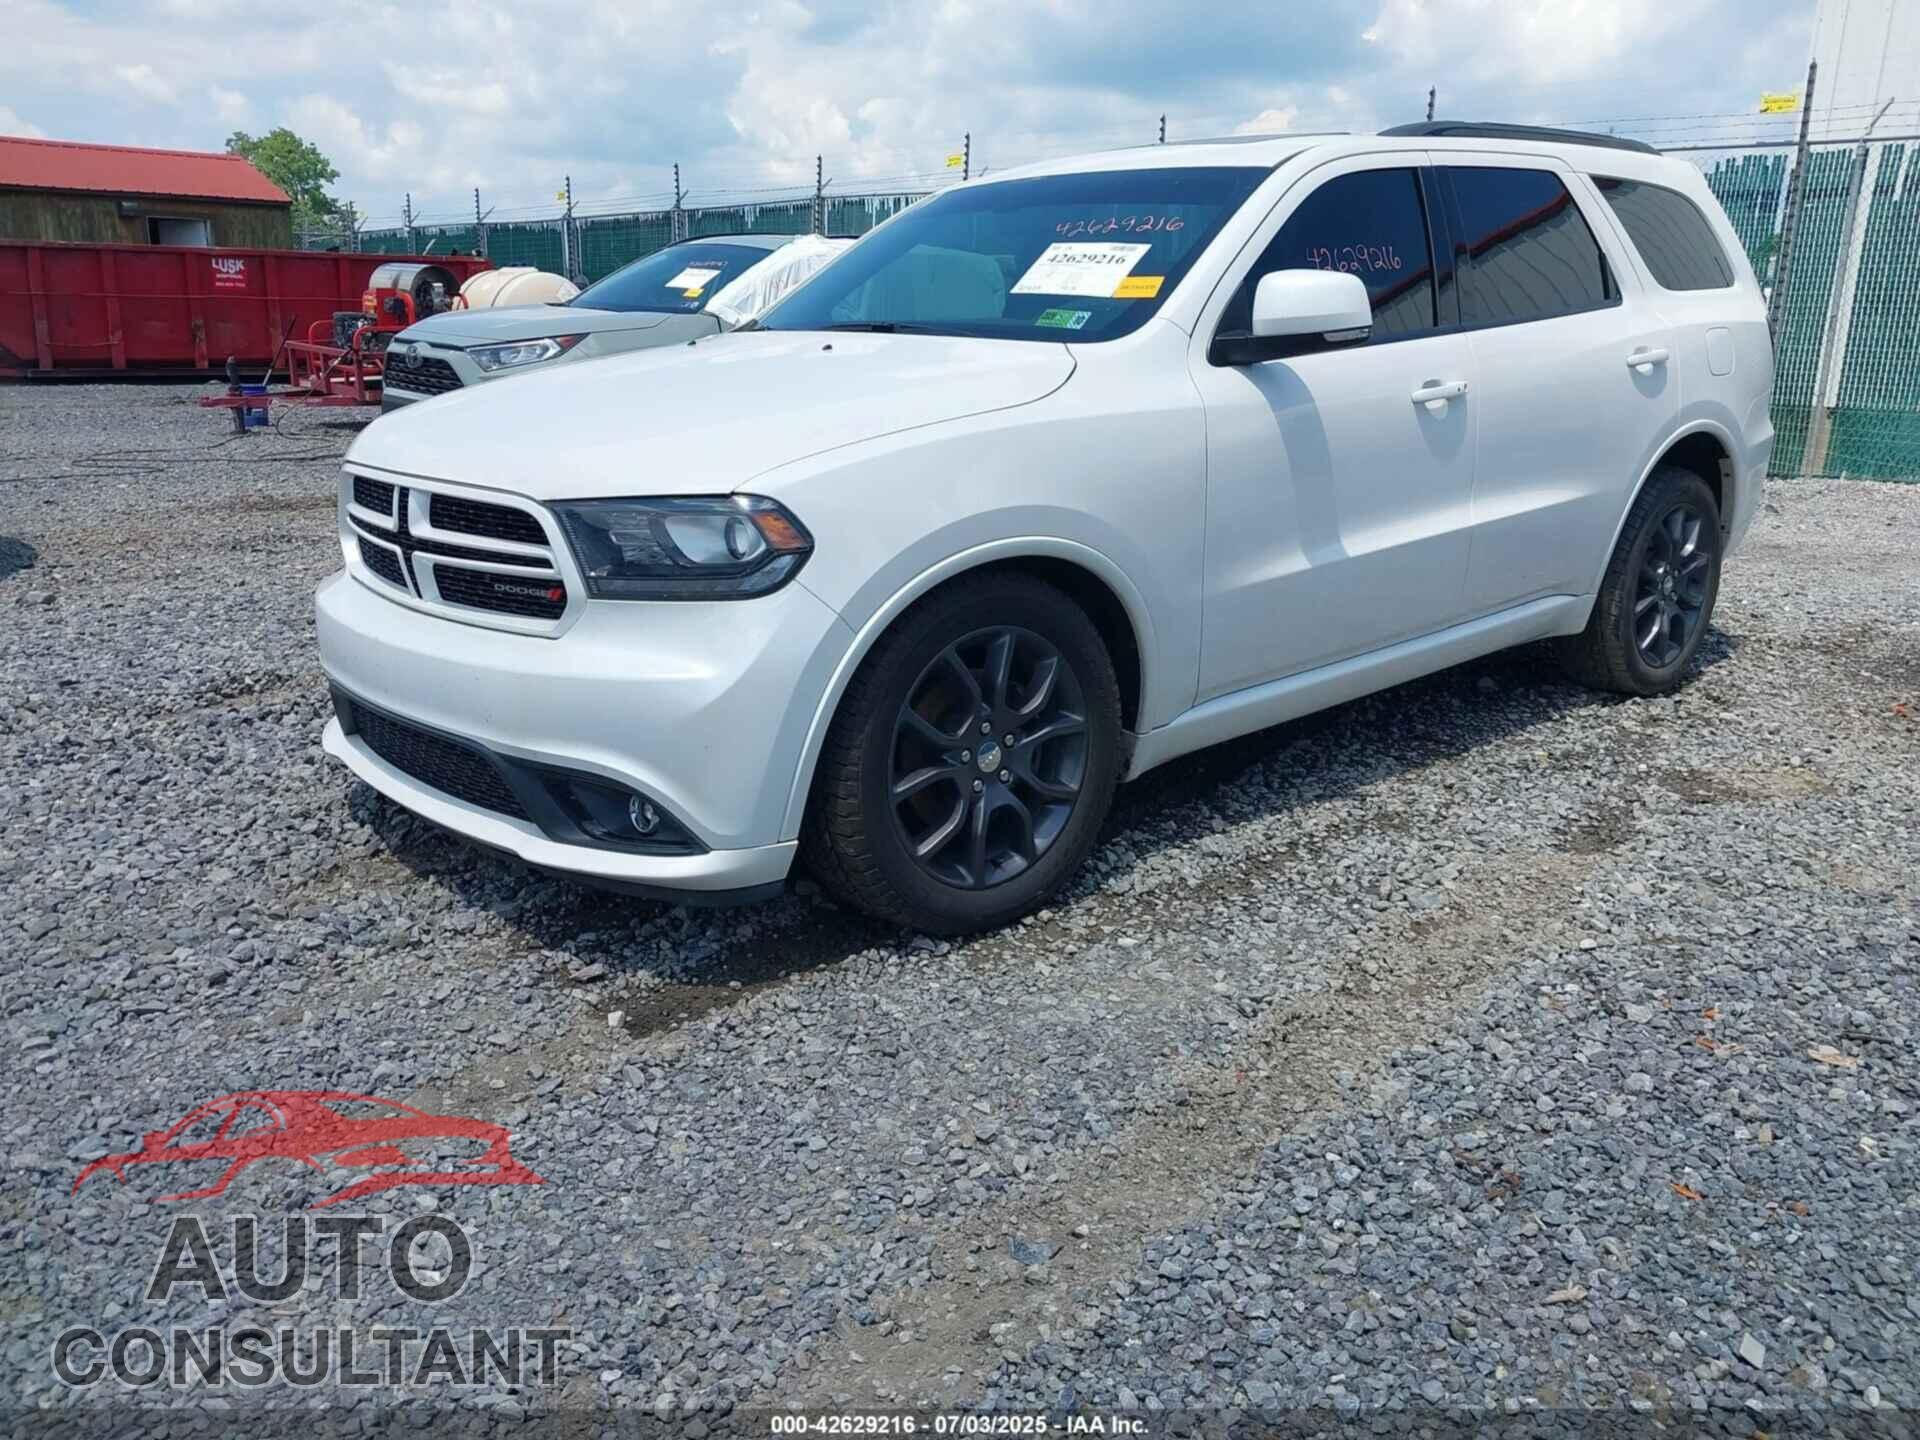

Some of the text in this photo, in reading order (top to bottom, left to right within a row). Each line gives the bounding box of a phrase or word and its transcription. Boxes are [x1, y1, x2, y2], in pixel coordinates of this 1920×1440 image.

[1055, 216, 1184, 237] 42629216
[211, 258, 245, 273] LUSK
[1047, 253, 1127, 264] 42629216
[1306, 244, 1402, 272] 42629216
[494, 583, 547, 598] DODGE
